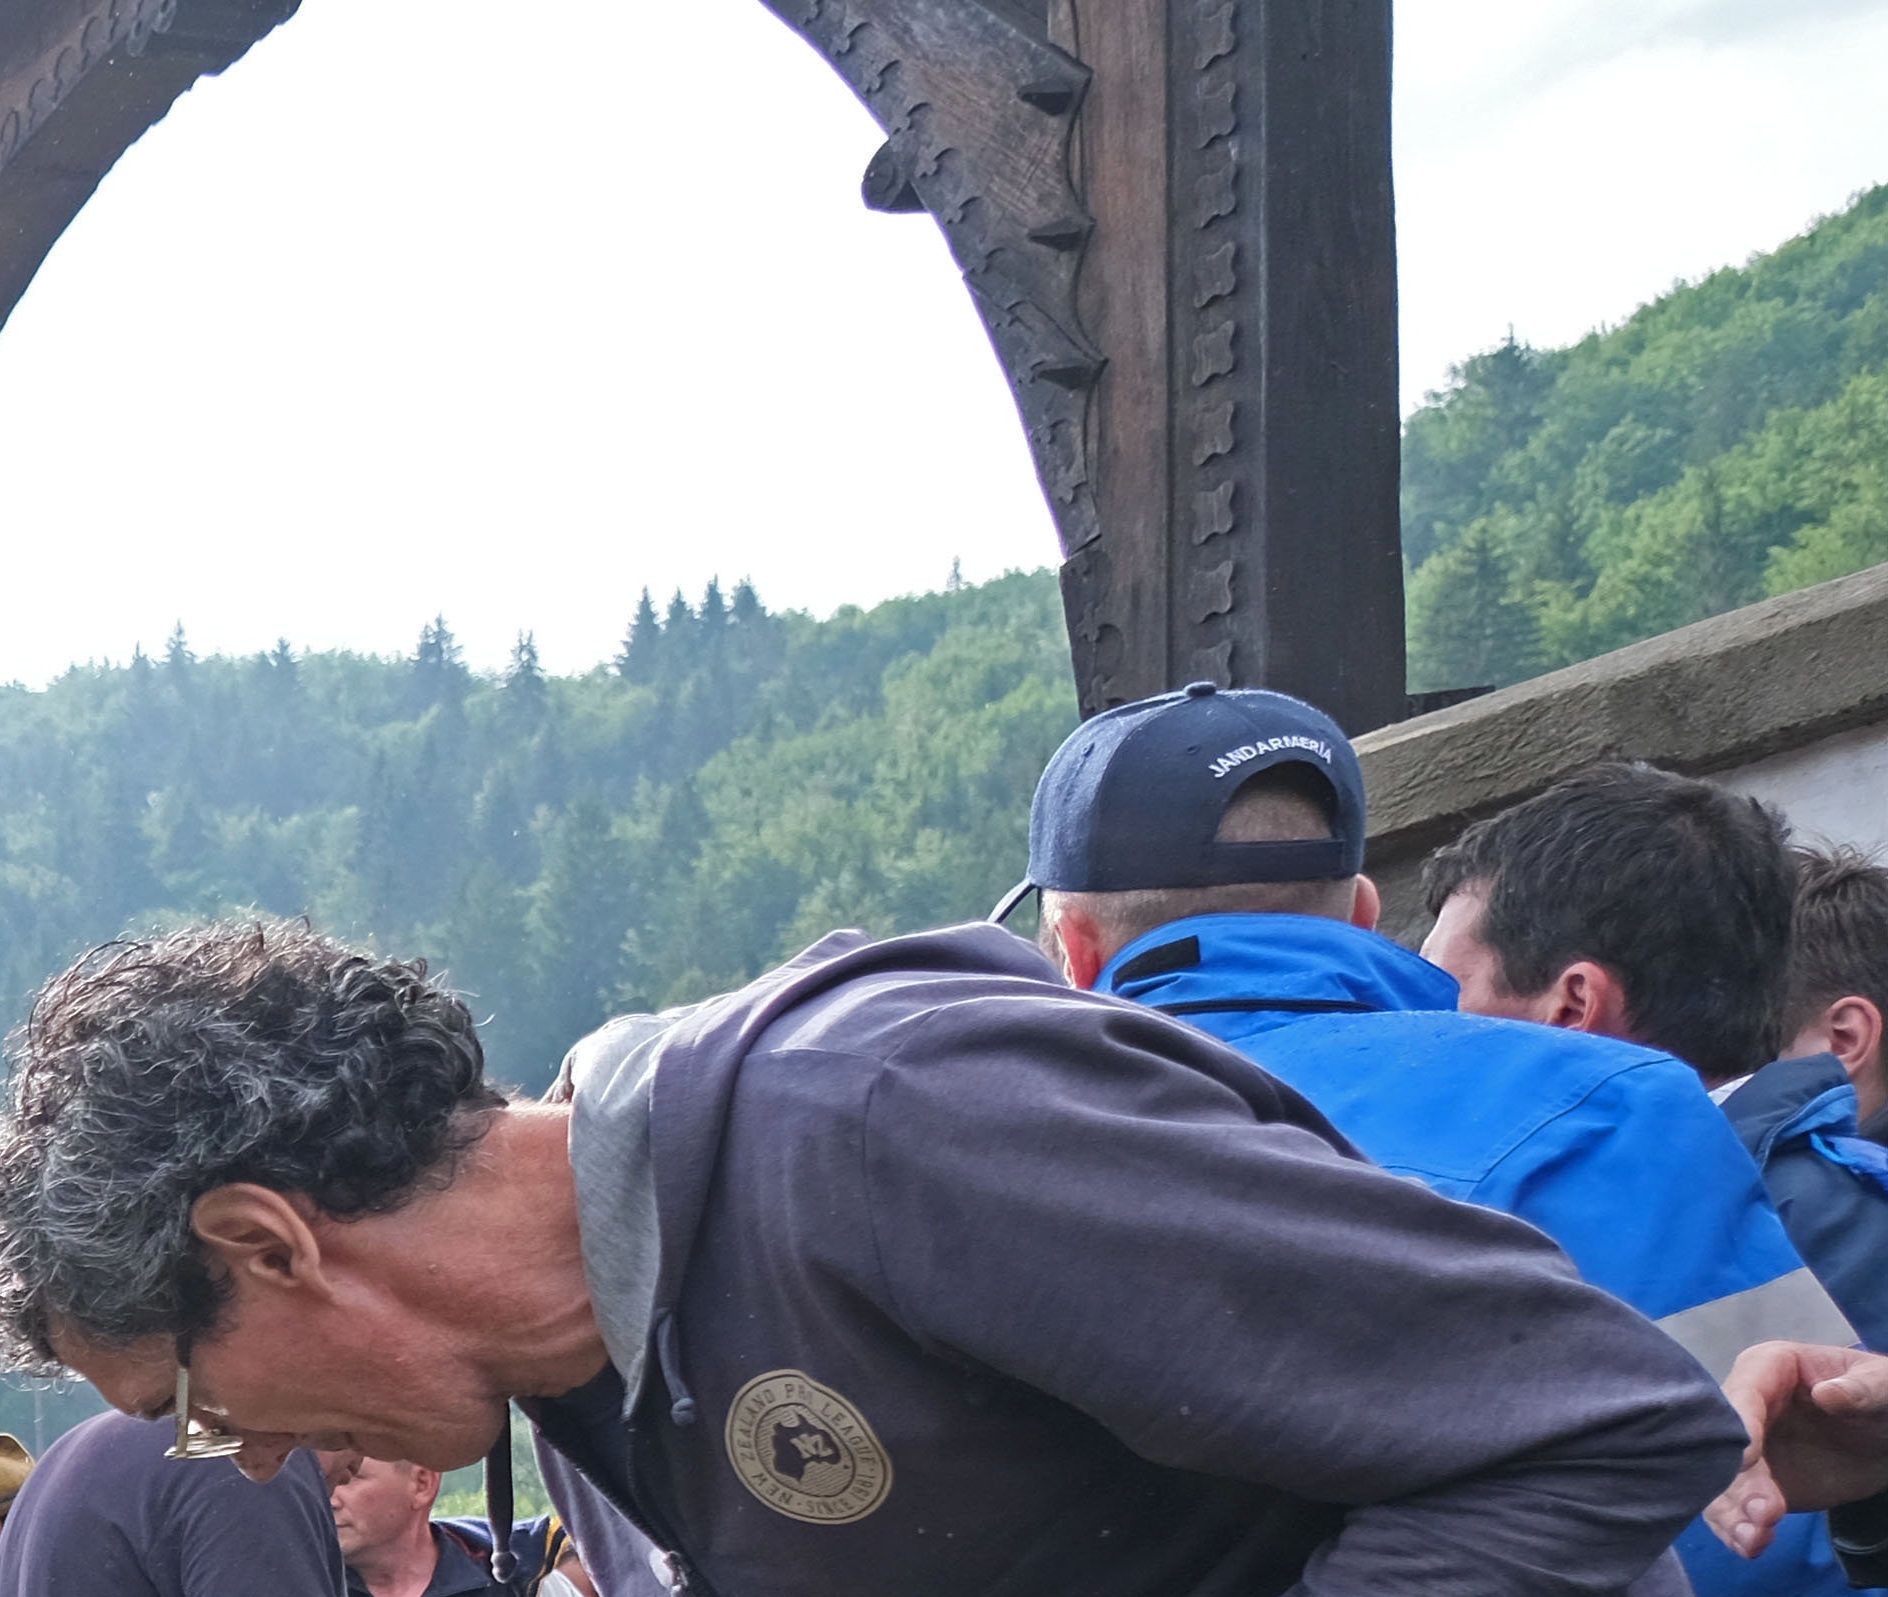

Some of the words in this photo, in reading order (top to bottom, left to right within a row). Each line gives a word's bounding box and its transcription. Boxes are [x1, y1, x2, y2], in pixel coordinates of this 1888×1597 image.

[1208, 735, 1332, 779] JANDARMERIA
[737, 1388, 774, 1462] ZEALAND
[821, 1402, 877, 1466] LEAGUE
[752, 1472, 793, 1506] NEW
